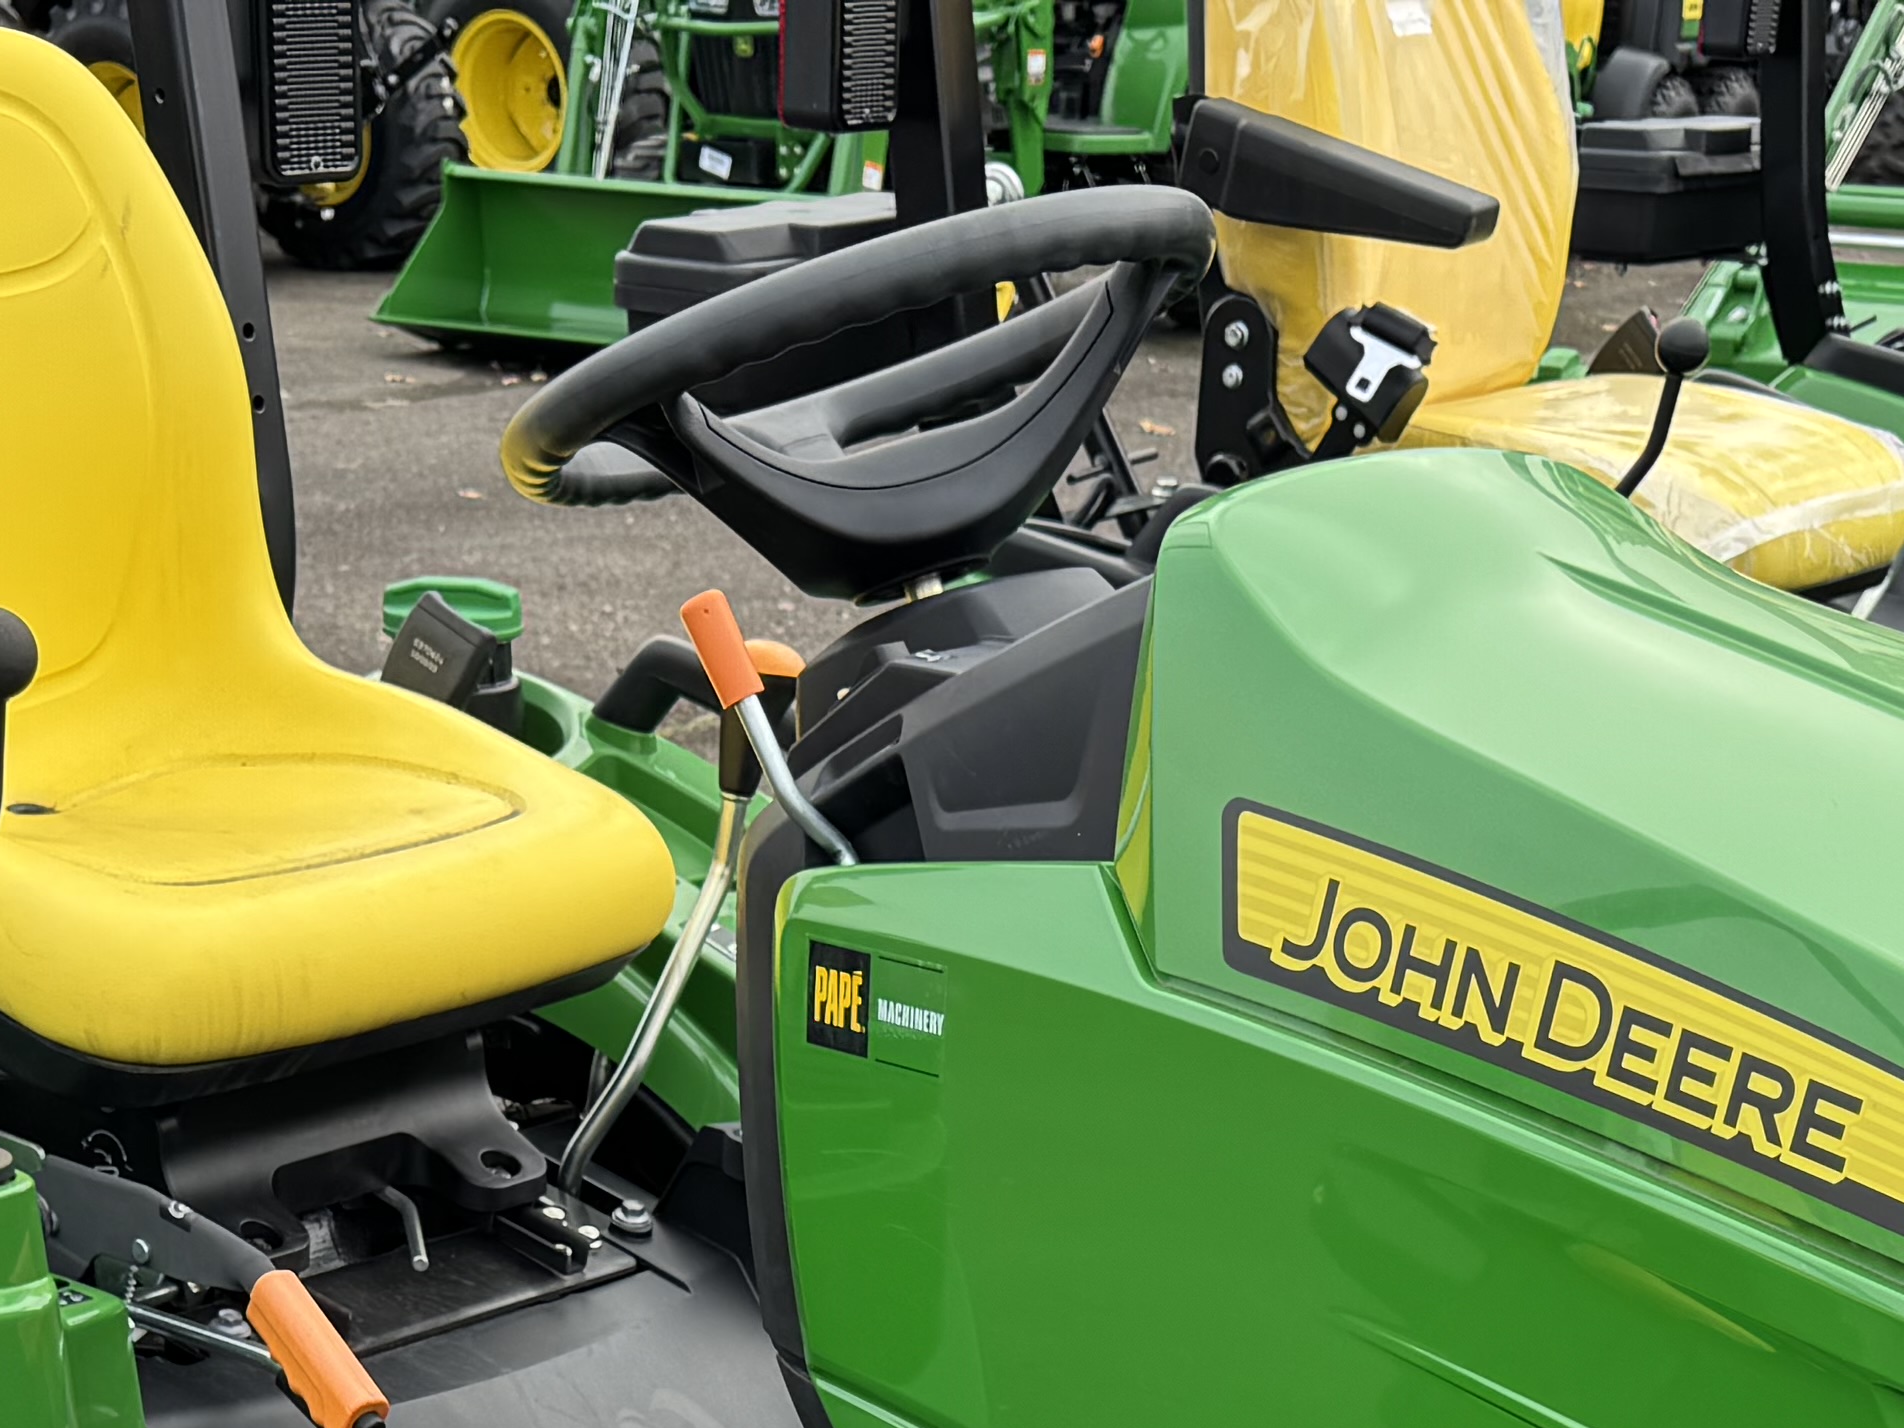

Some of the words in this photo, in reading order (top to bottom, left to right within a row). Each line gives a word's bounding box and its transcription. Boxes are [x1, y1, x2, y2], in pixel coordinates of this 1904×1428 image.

[878, 998, 944, 1037] MACHINERY
[1278, 876, 1521, 1040] JOHN
[1534, 959, 1862, 1172] DEERE
